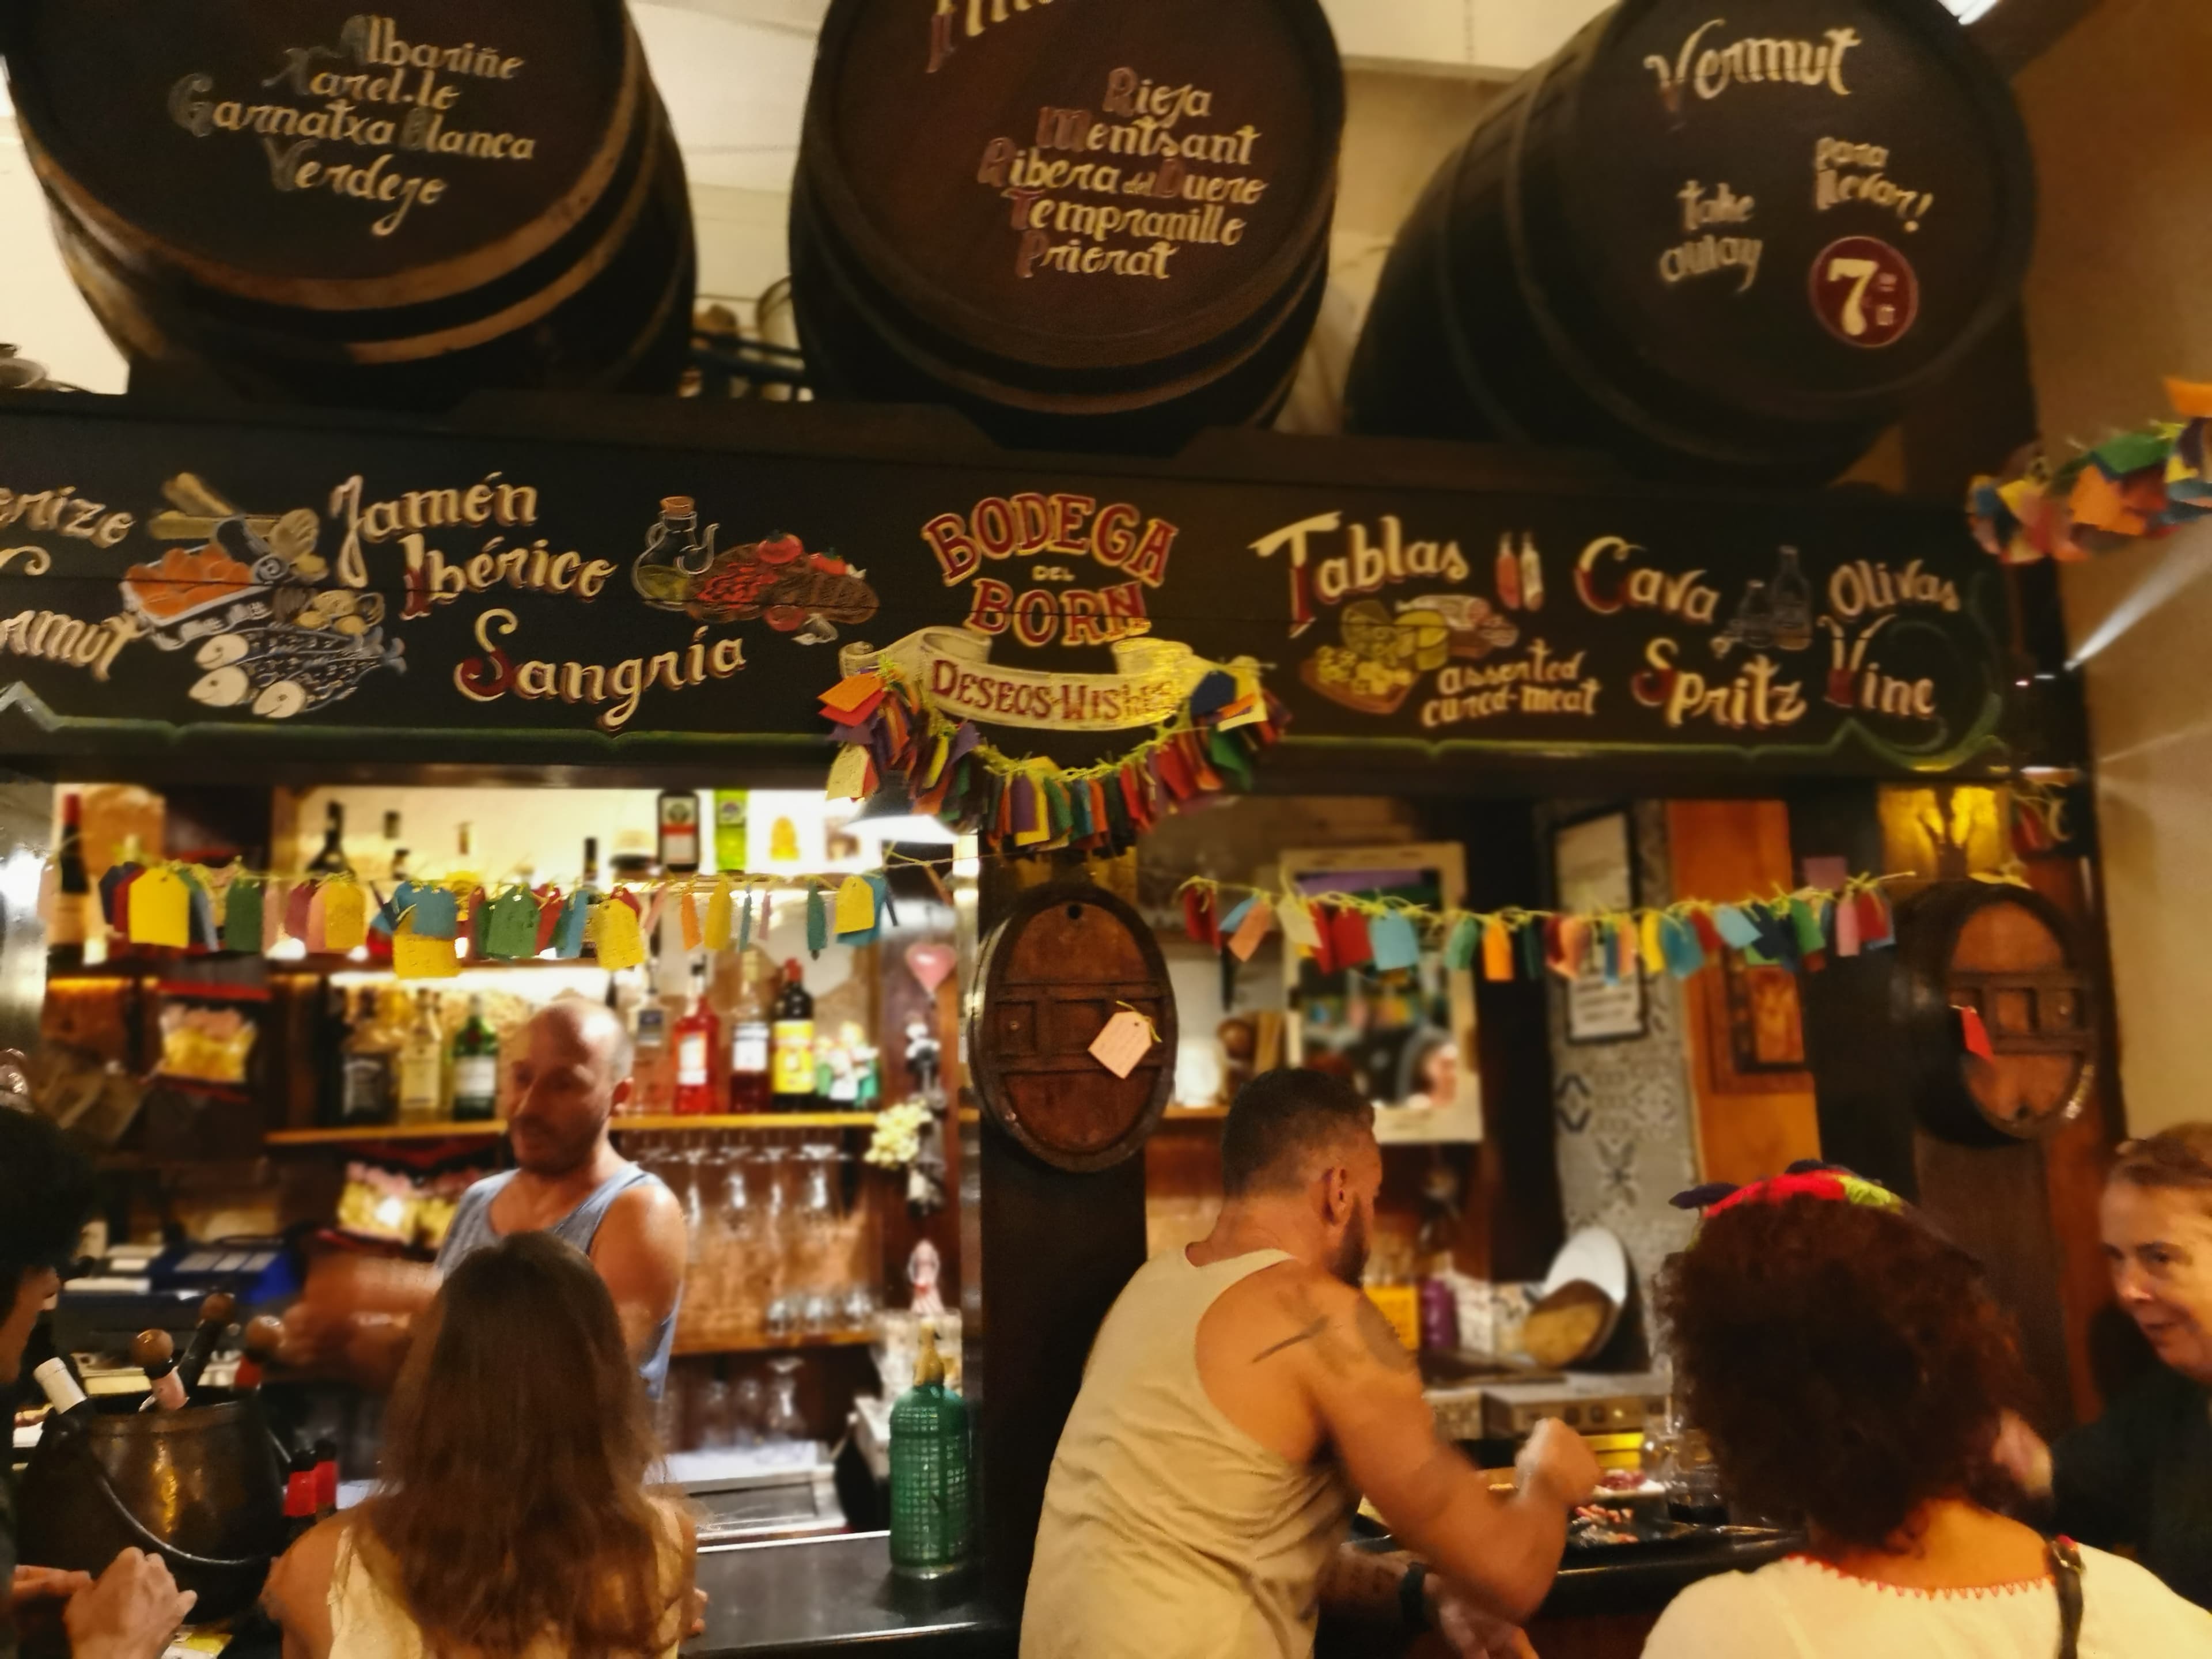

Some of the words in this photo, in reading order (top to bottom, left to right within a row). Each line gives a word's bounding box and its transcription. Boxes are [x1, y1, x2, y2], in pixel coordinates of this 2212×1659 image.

[1643, 19, 1862, 112] Vermut
[402, 107, 536, 159] Blanca
[977, 137, 1119, 192] Ribera
[921, 492, 1179, 588] BODEGA
[1031, 565, 1075, 582] DEL
[1247, 510, 1469, 639] Tablas
[1574, 536, 1721, 625] Cava
[964, 578, 1152, 647] BORN
[1829, 559, 1960, 618] Olivas
[453, 608, 747, 731] Sangría
[1631, 637, 1808, 728] Spritz
